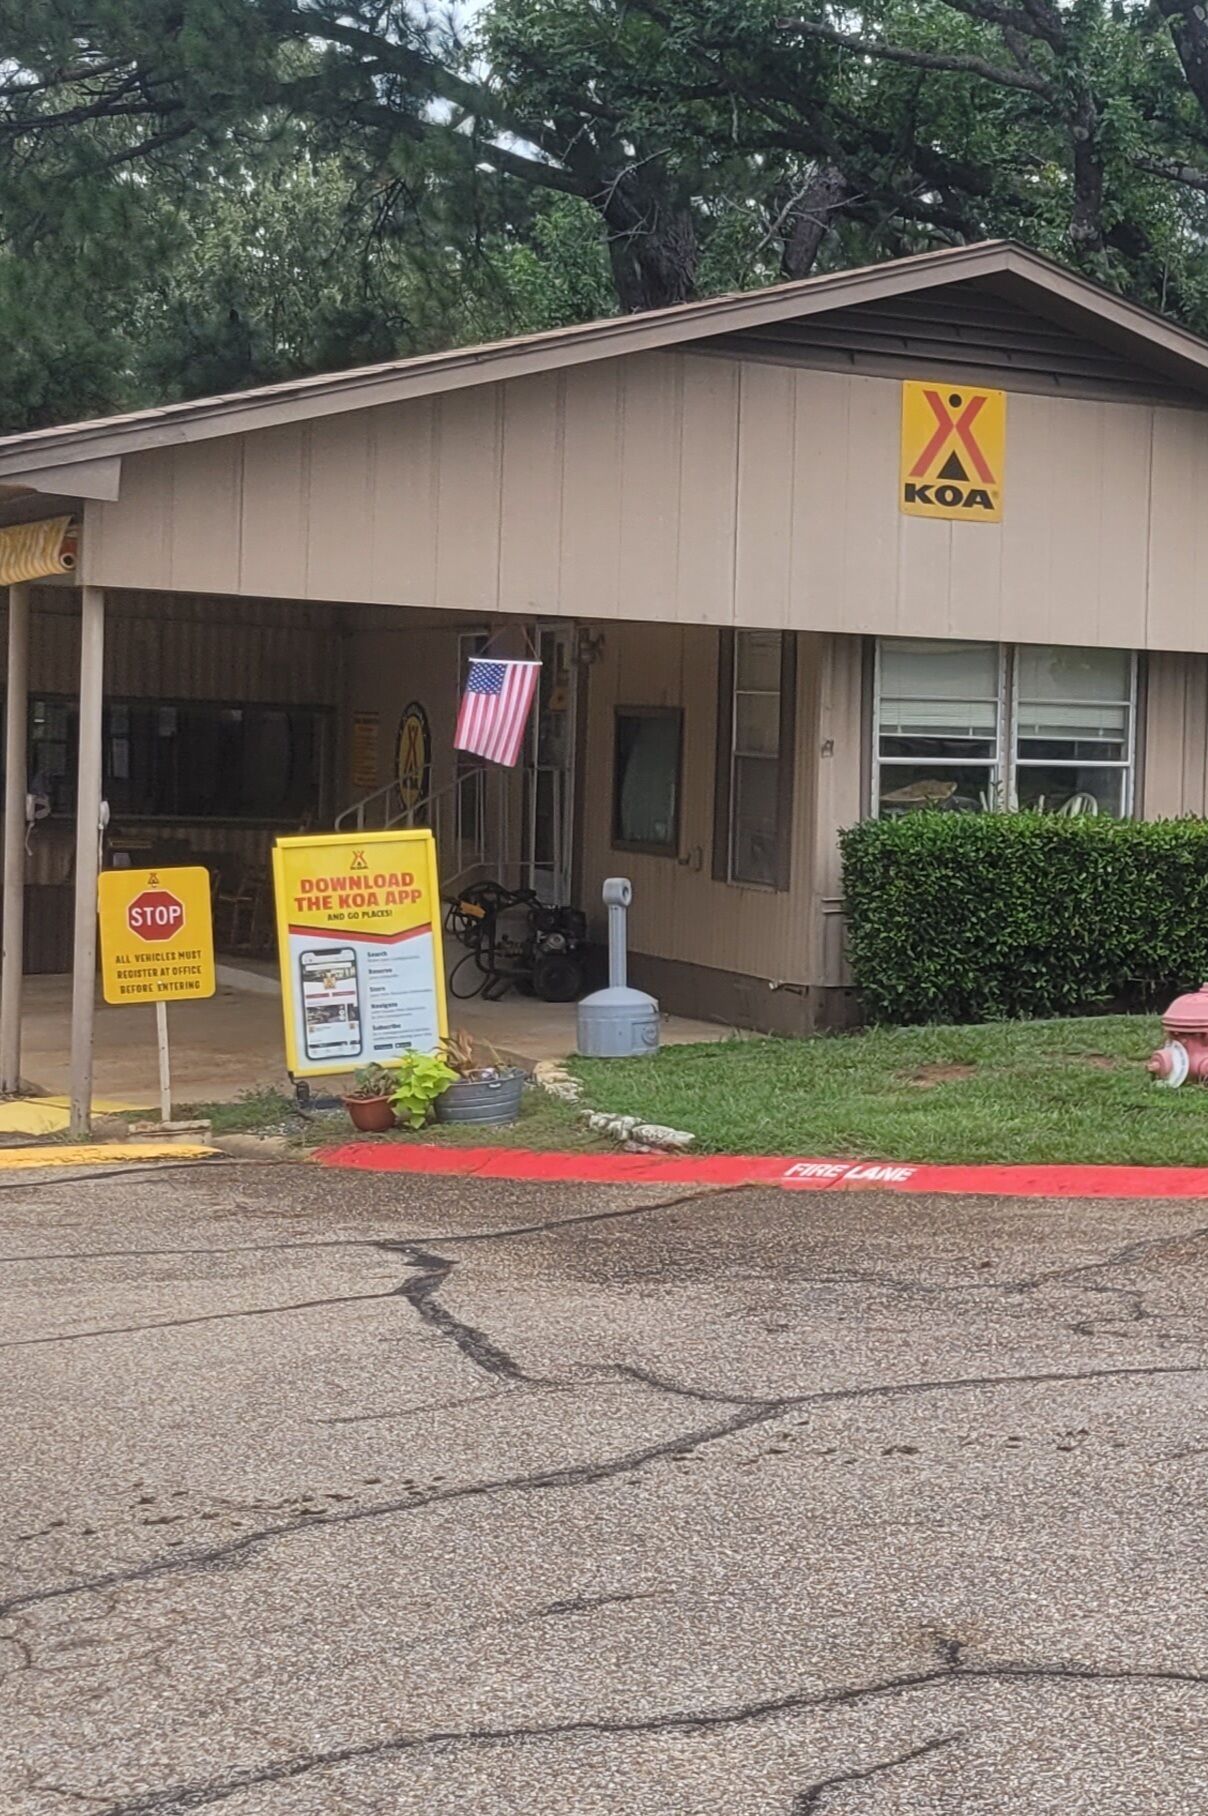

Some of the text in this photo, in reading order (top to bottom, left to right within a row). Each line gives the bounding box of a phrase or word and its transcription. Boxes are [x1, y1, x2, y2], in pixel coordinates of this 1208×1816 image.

[905, 483, 995, 510] KOA
[300, 872, 415, 894] DOWNLOAD
[294, 888, 423, 912] THE KOA APP
[130, 906, 181, 927] STOP
[327, 909, 393, 921] AND GO PLACES!
[115, 950, 202, 964] ALL VEHICLES MUST
[117, 965, 202, 979] REGISTER AT OFFICE
[120, 980, 201, 994] BEFORE ENTERING
[783, 1163, 918, 1182] FIRE LANE
